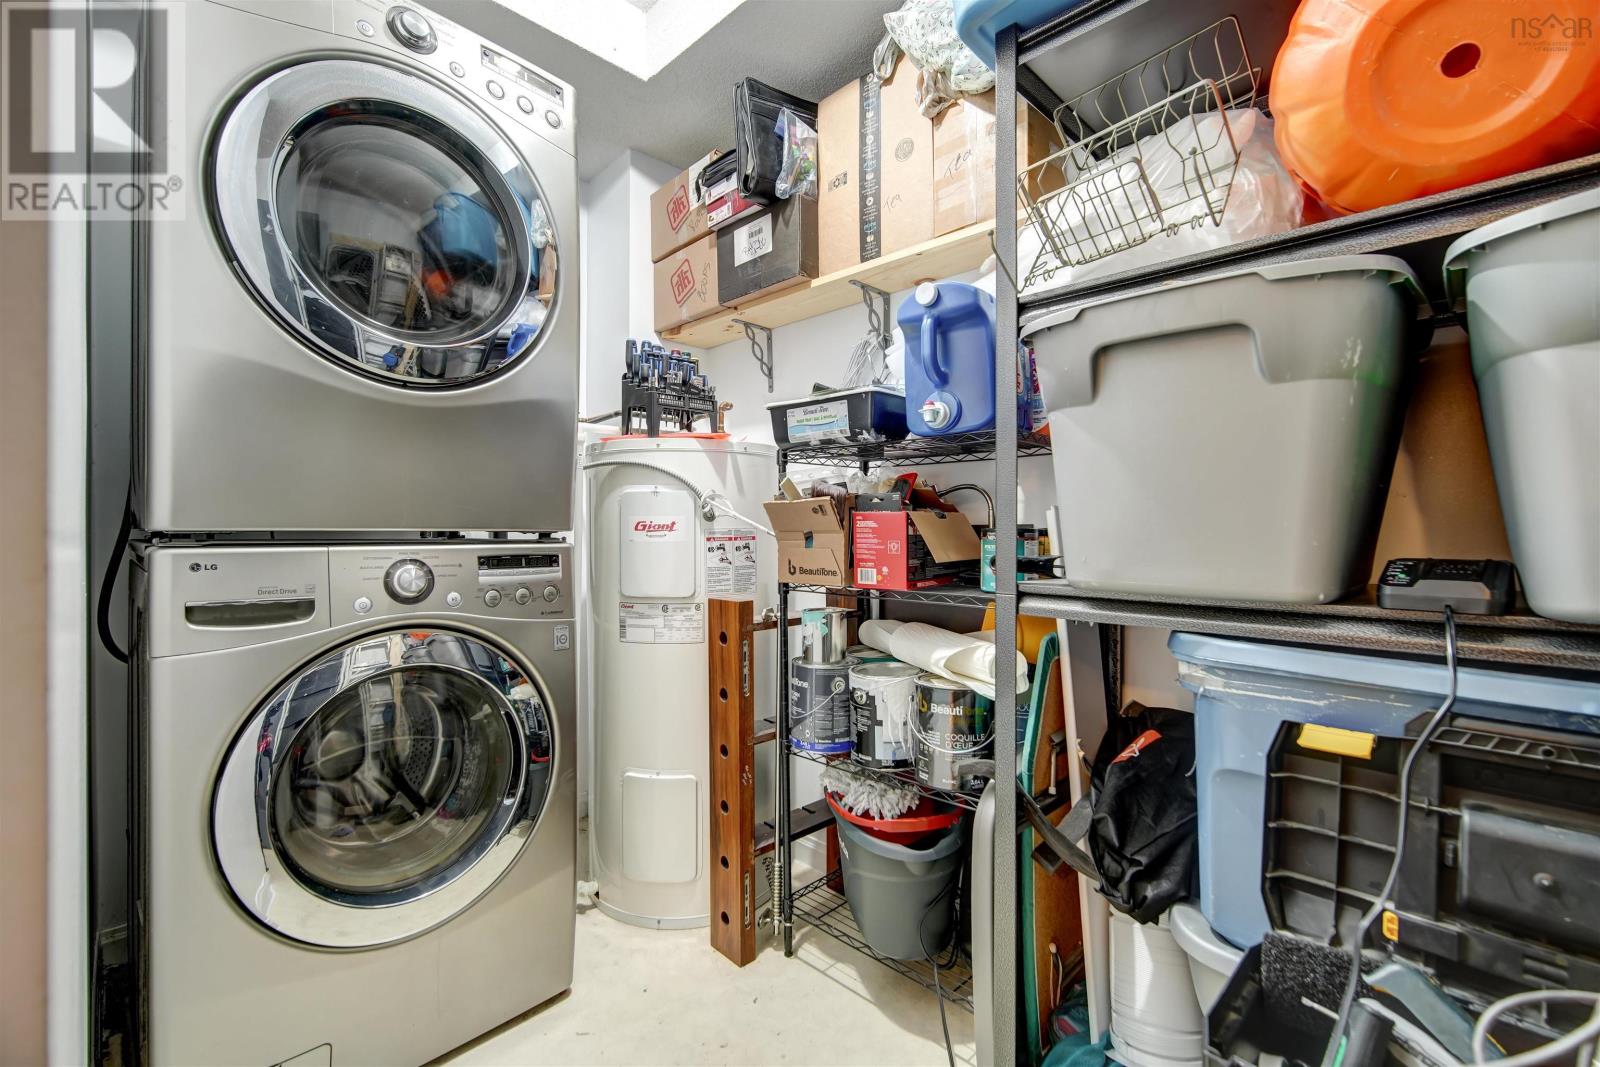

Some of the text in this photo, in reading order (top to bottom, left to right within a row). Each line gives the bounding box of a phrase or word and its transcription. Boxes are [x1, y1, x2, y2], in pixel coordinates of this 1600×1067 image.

[634, 520, 678, 533] Giant
[204, 563, 218, 571] LG
[799, 566, 838, 577] BeautiTone
[257, 588, 279, 596] Direct
[945, 733, 985, 742] COQUILLE
